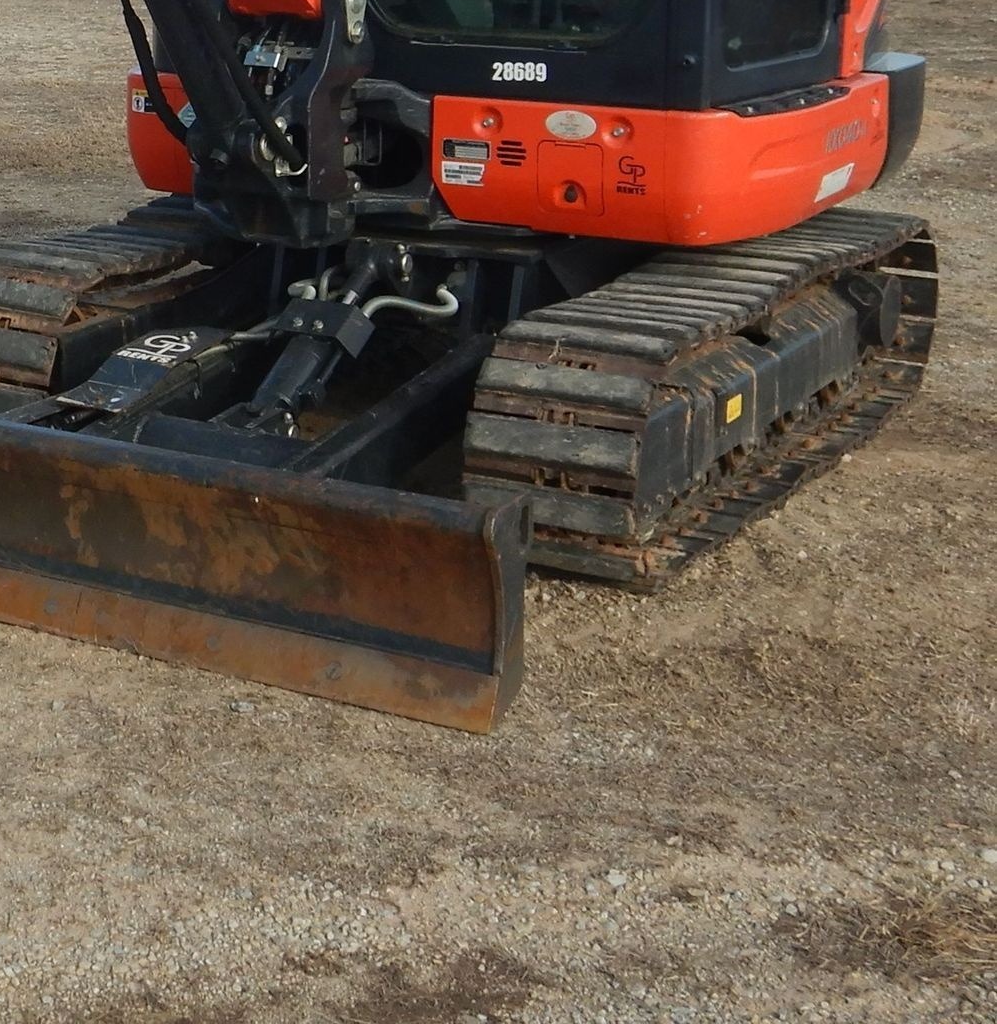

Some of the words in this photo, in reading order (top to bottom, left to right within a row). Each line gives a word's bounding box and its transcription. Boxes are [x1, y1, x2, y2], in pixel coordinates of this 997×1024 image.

[492, 62, 547, 82] 28689
[618, 156, 646, 183] GP
[616, 186, 646, 195] RENTS
[144, 335, 191, 356] GP
[117, 350, 171, 363] RENTS
